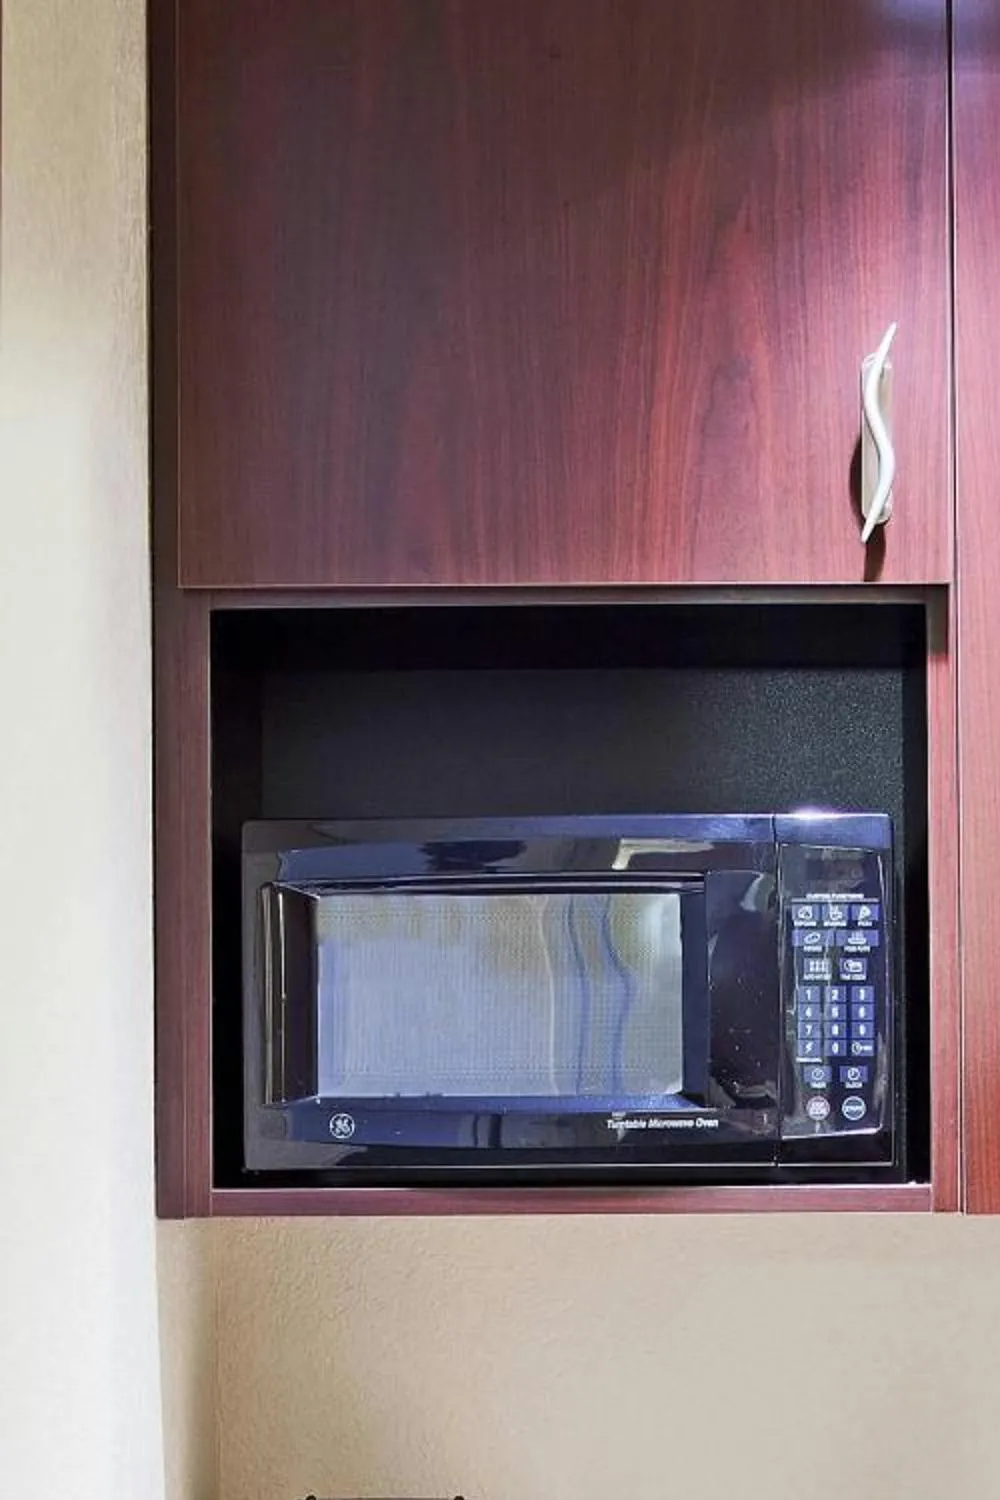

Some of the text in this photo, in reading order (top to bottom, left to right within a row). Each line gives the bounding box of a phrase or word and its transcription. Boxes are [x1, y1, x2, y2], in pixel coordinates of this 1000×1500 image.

[607, 1117, 719, 1129] Turntable Microwave Oven
